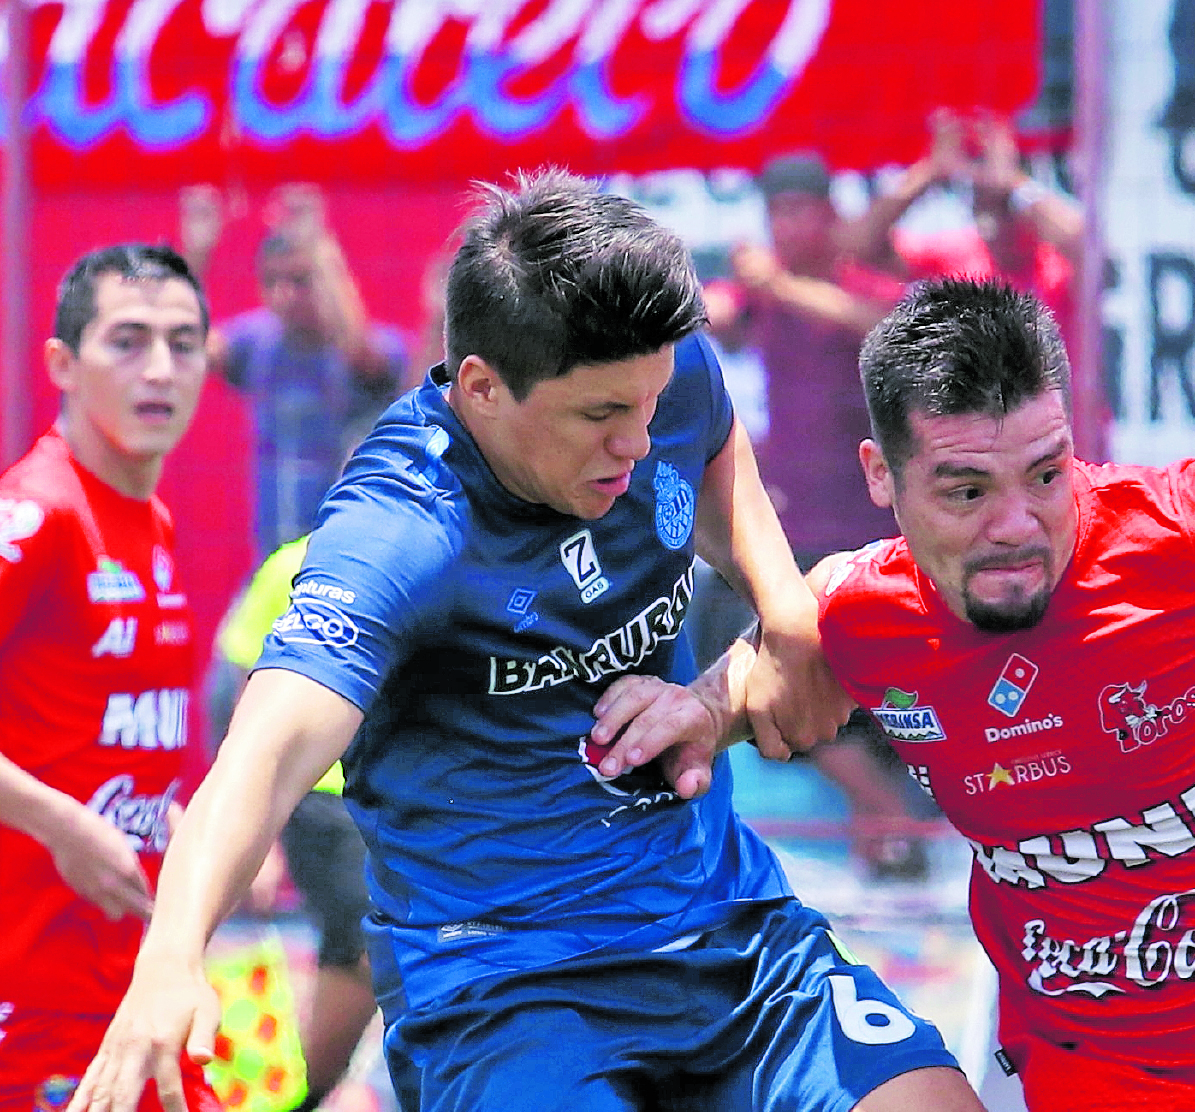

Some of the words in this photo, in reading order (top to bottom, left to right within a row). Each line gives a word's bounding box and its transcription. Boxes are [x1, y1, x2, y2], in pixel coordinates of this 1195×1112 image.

[563, 535, 597, 584] Z
[489, 553, 697, 696] BANRURA
[984, 713, 1064, 744] Domino's
[827, 974, 916, 1046] 6
